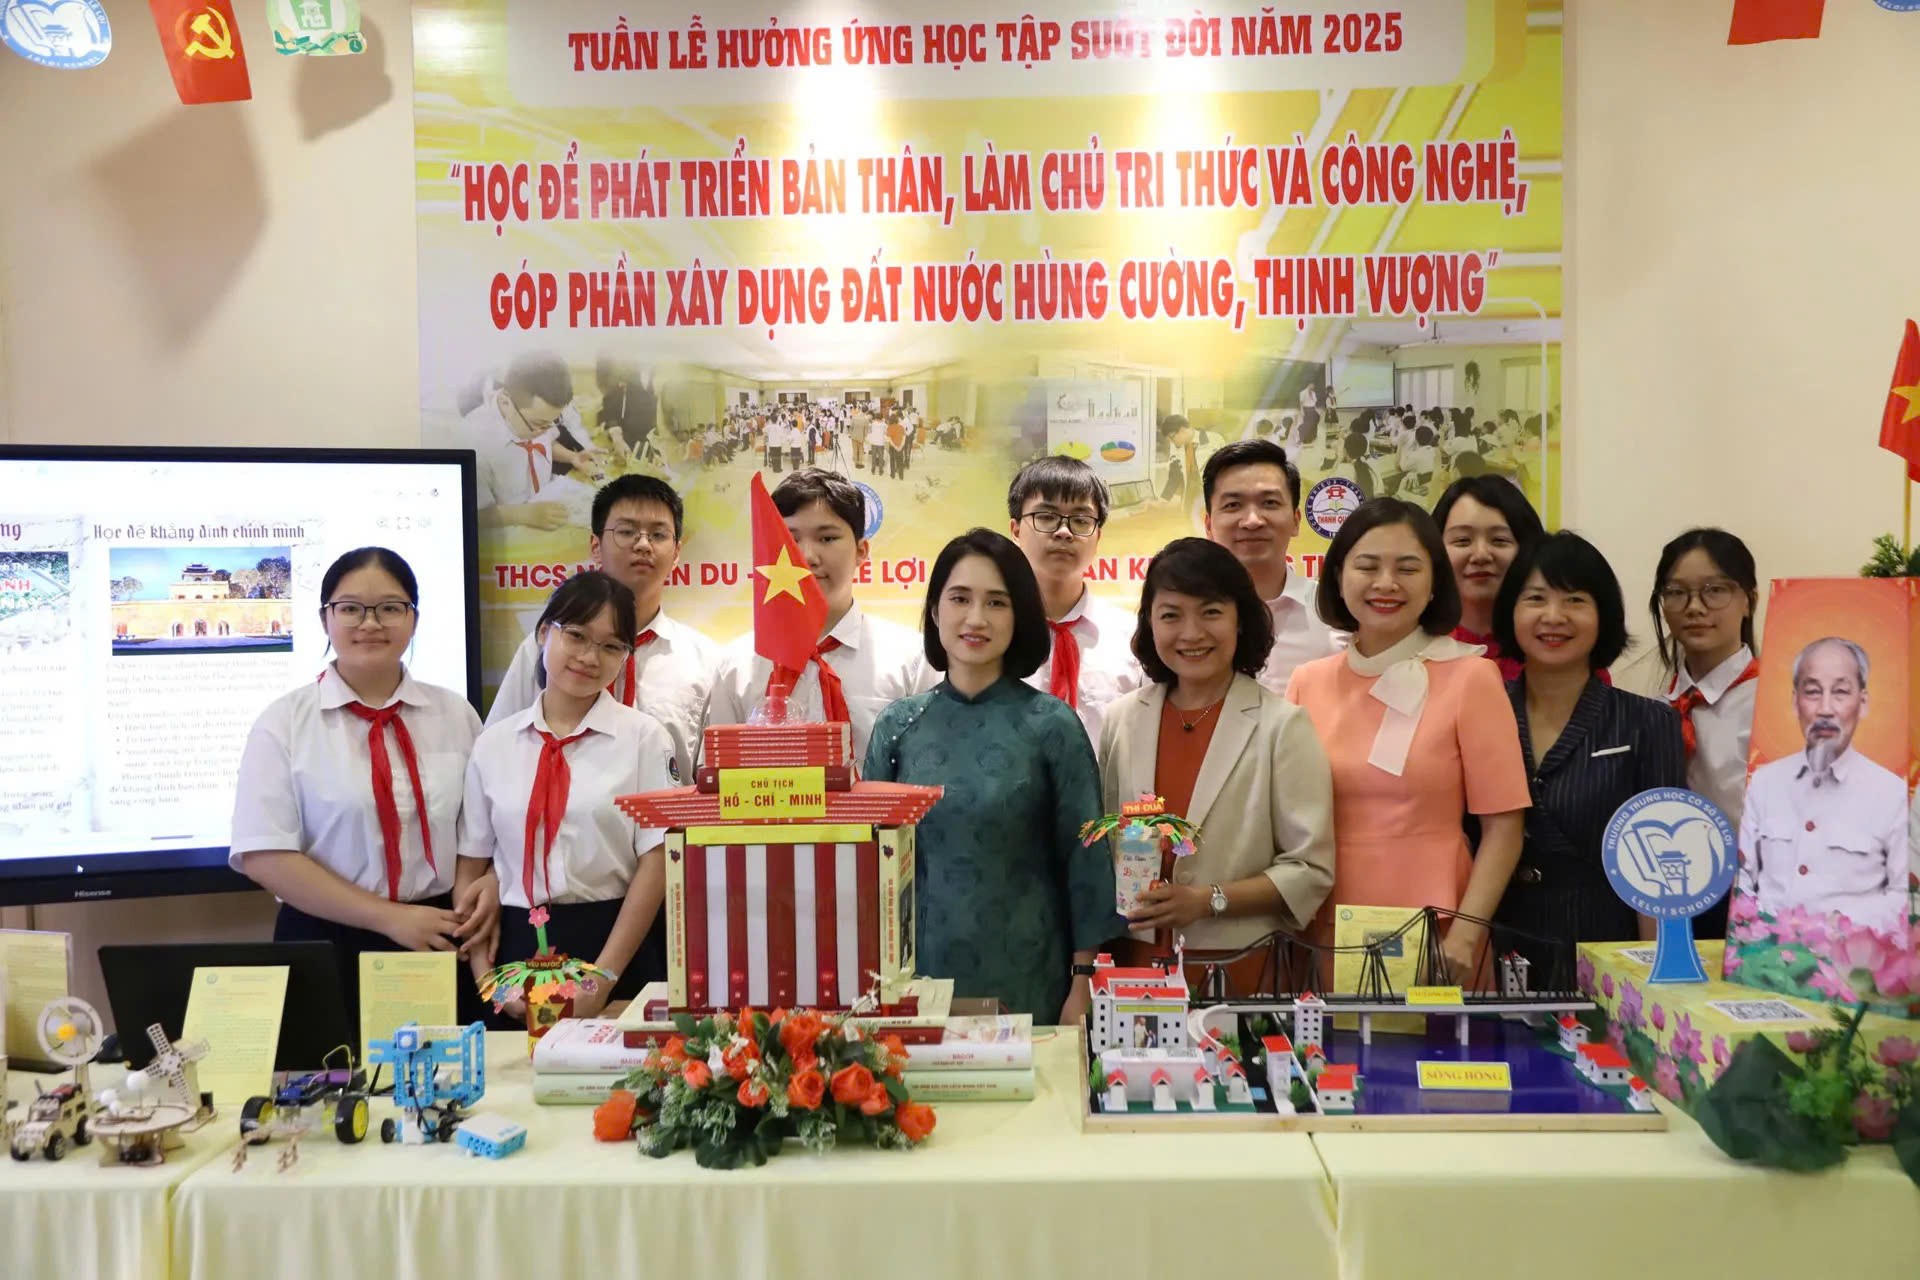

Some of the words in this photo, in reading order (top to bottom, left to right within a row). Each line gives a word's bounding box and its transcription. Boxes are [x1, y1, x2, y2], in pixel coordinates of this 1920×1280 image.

[568, 16, 658, 71] TUẦN
[669, 15, 707, 70] LỄ
[717, 17, 832, 68] HƯỞNG
[842, 19, 913, 66] ỨNG
[923, 23, 987, 71] HỌC
[996, 14, 1061, 69] TẬP
[1165, 9, 1221, 58] ĐỜI
[1232, 6, 1312, 56] NĂM
[1323, 12, 1402, 54] 2025
[539, 141, 579, 220] ĐỂ
[590, 149, 671, 219] PHÁT
[680, 138, 770, 217] TRIỂN
[783, 143, 847, 216] BẢN
[857, 145, 955, 226] THÂN,
[964, 142, 1031, 212] LÀM
[1042, 136, 1104, 210] CHỦ
[1115, 151, 1164, 208] TRI
[1176, 136, 1258, 208] THỨC
[1267, 135, 1312, 205] VÀ
[1322, 134, 1415, 205] CÔNG
[1426, 130, 1528, 216] NGHỆ,
[490, 259, 557, 331] GÓP
[569, 251, 656, 329] PHẦN
[666, 257, 728, 327] XÂY
[738, 267, 830, 341] DỰNG
[841, 247, 902, 324] ĐẤT
[914, 250, 1003, 324] NƯỚC
[1015, 249, 1108, 320] HÙNG
[1121, 247, 1245, 330] CƯỜNG,
[1255, 257, 1354, 331] THỊNH
[495, 565, 567, 588] THCS
[701, 563, 738, 585] DU
[882, 557, 925, 590] LỢI
[754, 792, 775, 807] CHÍ
[789, 794, 822, 806] MINH
[1670, 891, 1719, 916] SCHOOL
